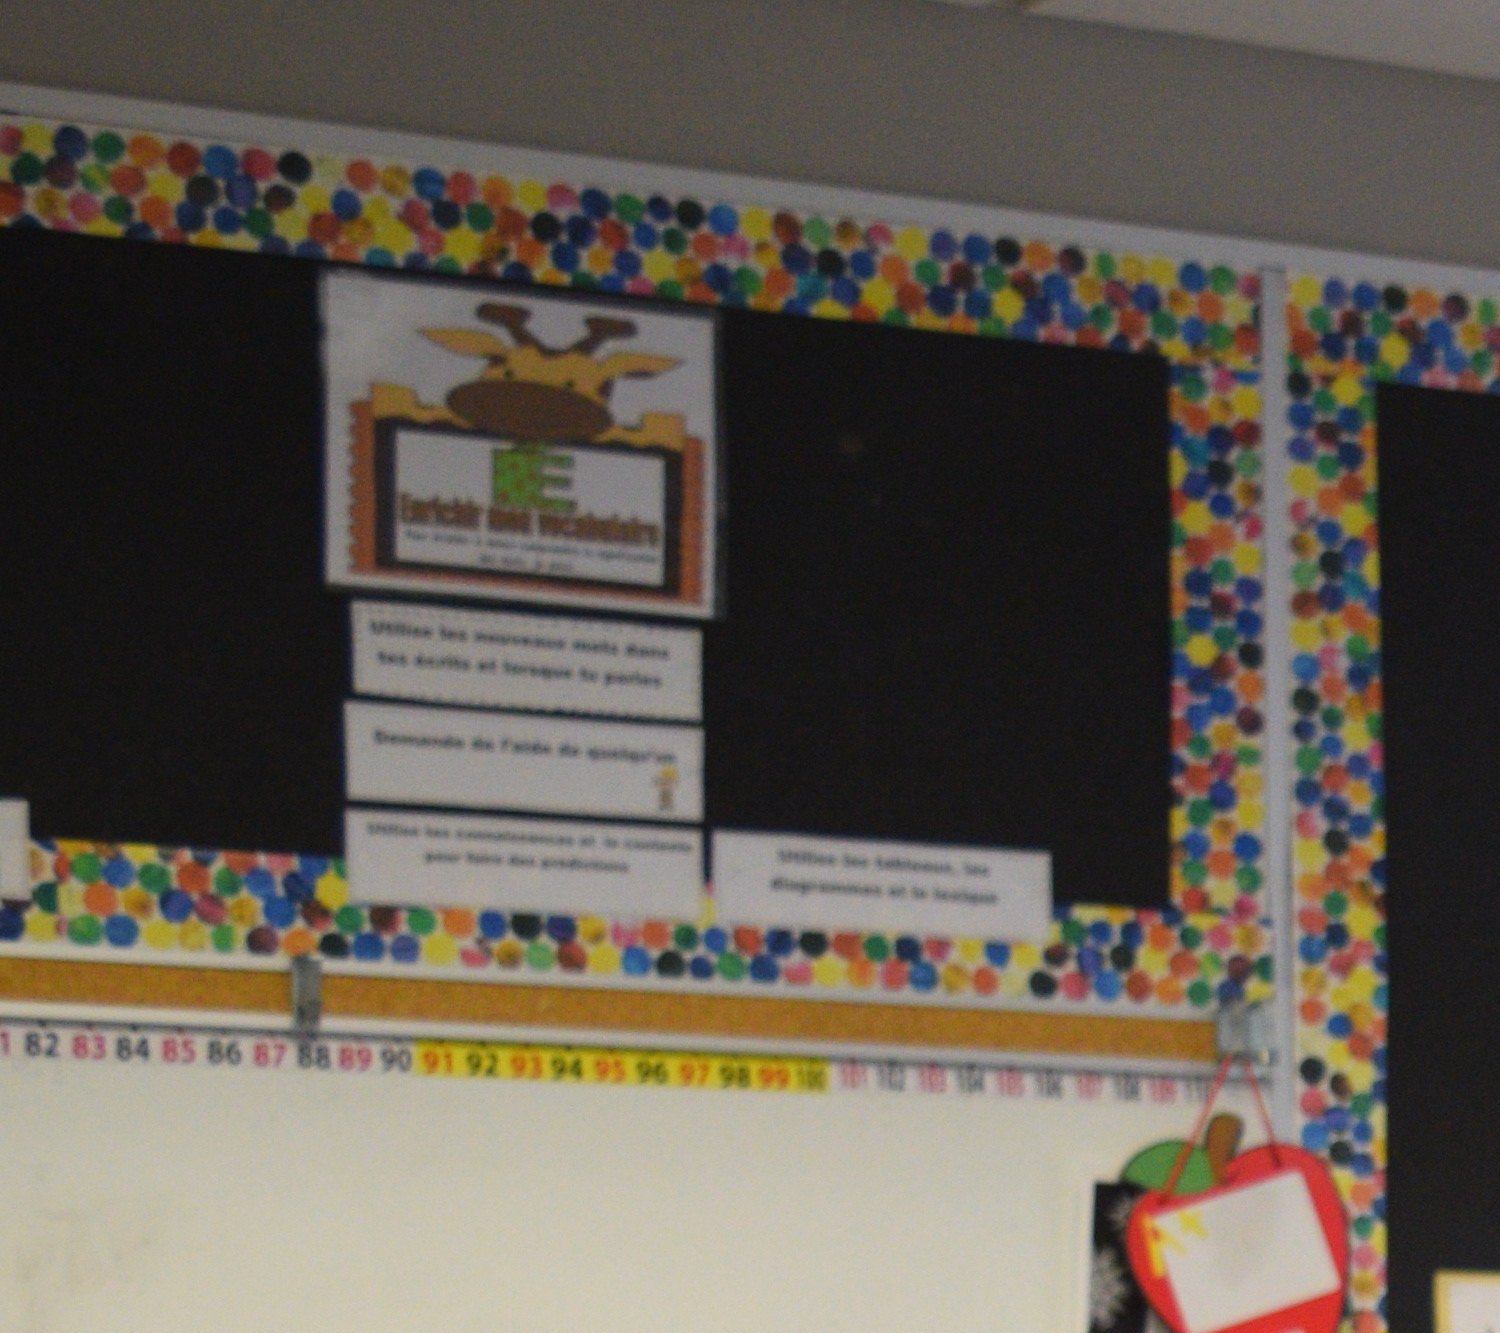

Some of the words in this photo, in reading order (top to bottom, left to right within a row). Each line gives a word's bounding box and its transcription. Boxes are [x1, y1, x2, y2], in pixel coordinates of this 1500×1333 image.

[25, 1032, 60, 1058] 82
[72, 1035, 106, 1060] 83
[116, 1037, 150, 1062] 84
[161, 1037, 197, 1063] 85
[207, 1040, 241, 1065] 86
[252, 1040, 286, 1067] 87
[298, 1042, 331, 1069] 88
[338, 1044, 372, 1070] 89
[380, 1044, 412, 1072] 90
[422, 1050, 454, 1074] 91
[466, 1050, 498, 1078] 92
[510, 1054, 543, 1079] 93
[551, 1055, 583, 1080] 94
[595, 1057, 625, 1082] 95
[635, 1058, 668, 1085] 96
[679, 1061, 709, 1087] 97
[719, 1062, 751, 1088] 98
[758, 1064, 789, 1091] 99
